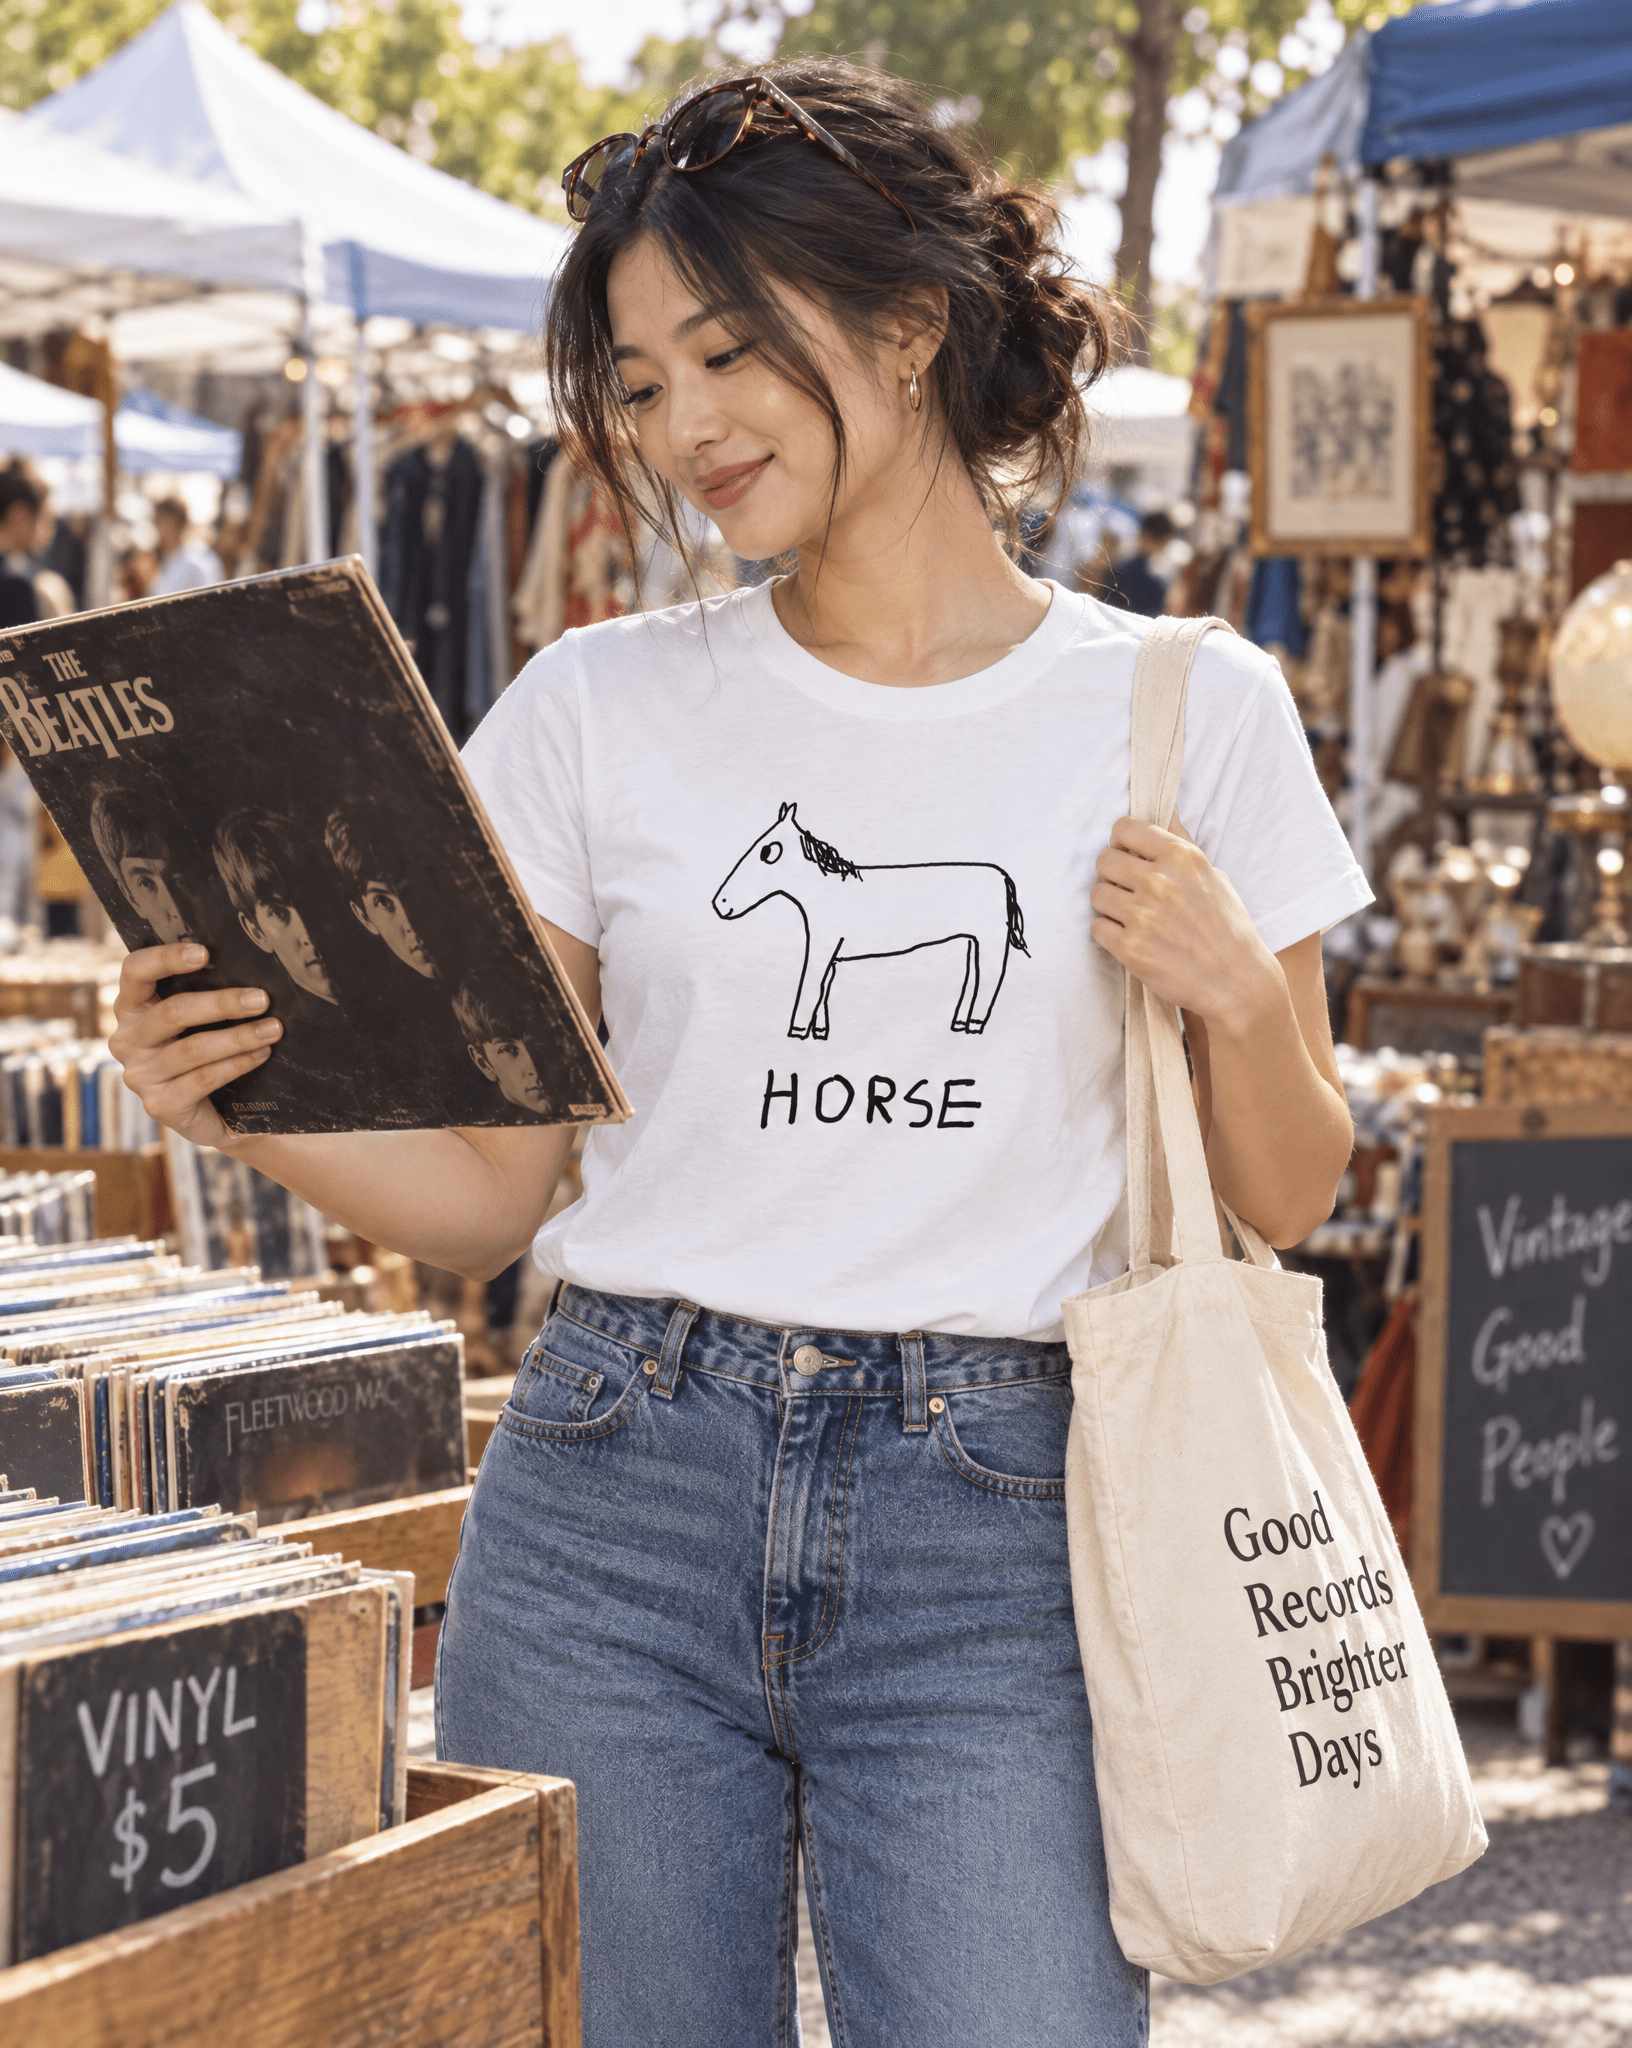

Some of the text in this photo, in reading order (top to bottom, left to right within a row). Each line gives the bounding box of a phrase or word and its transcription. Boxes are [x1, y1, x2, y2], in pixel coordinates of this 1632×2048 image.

[42, 649, 88, 682] THE
[0, 676, 175, 759] BEATLES
[760, 1069, 982, 1129] HORSE
[1476, 1192, 1632, 1288] Vintage
[1471, 1293, 1587, 1394] Good
[225, 1384, 348, 1456] FLEETWOOD
[1480, 1397, 1620, 1509] People
[1224, 1490, 1334, 1562] Good
[1243, 1555, 1394, 1638] Records
[1265, 1639, 1408, 1713] Brighter
[77, 1665, 257, 1778] VINYL
[1288, 1728, 1382, 1789] Days
[109, 1761, 217, 1893] $5
